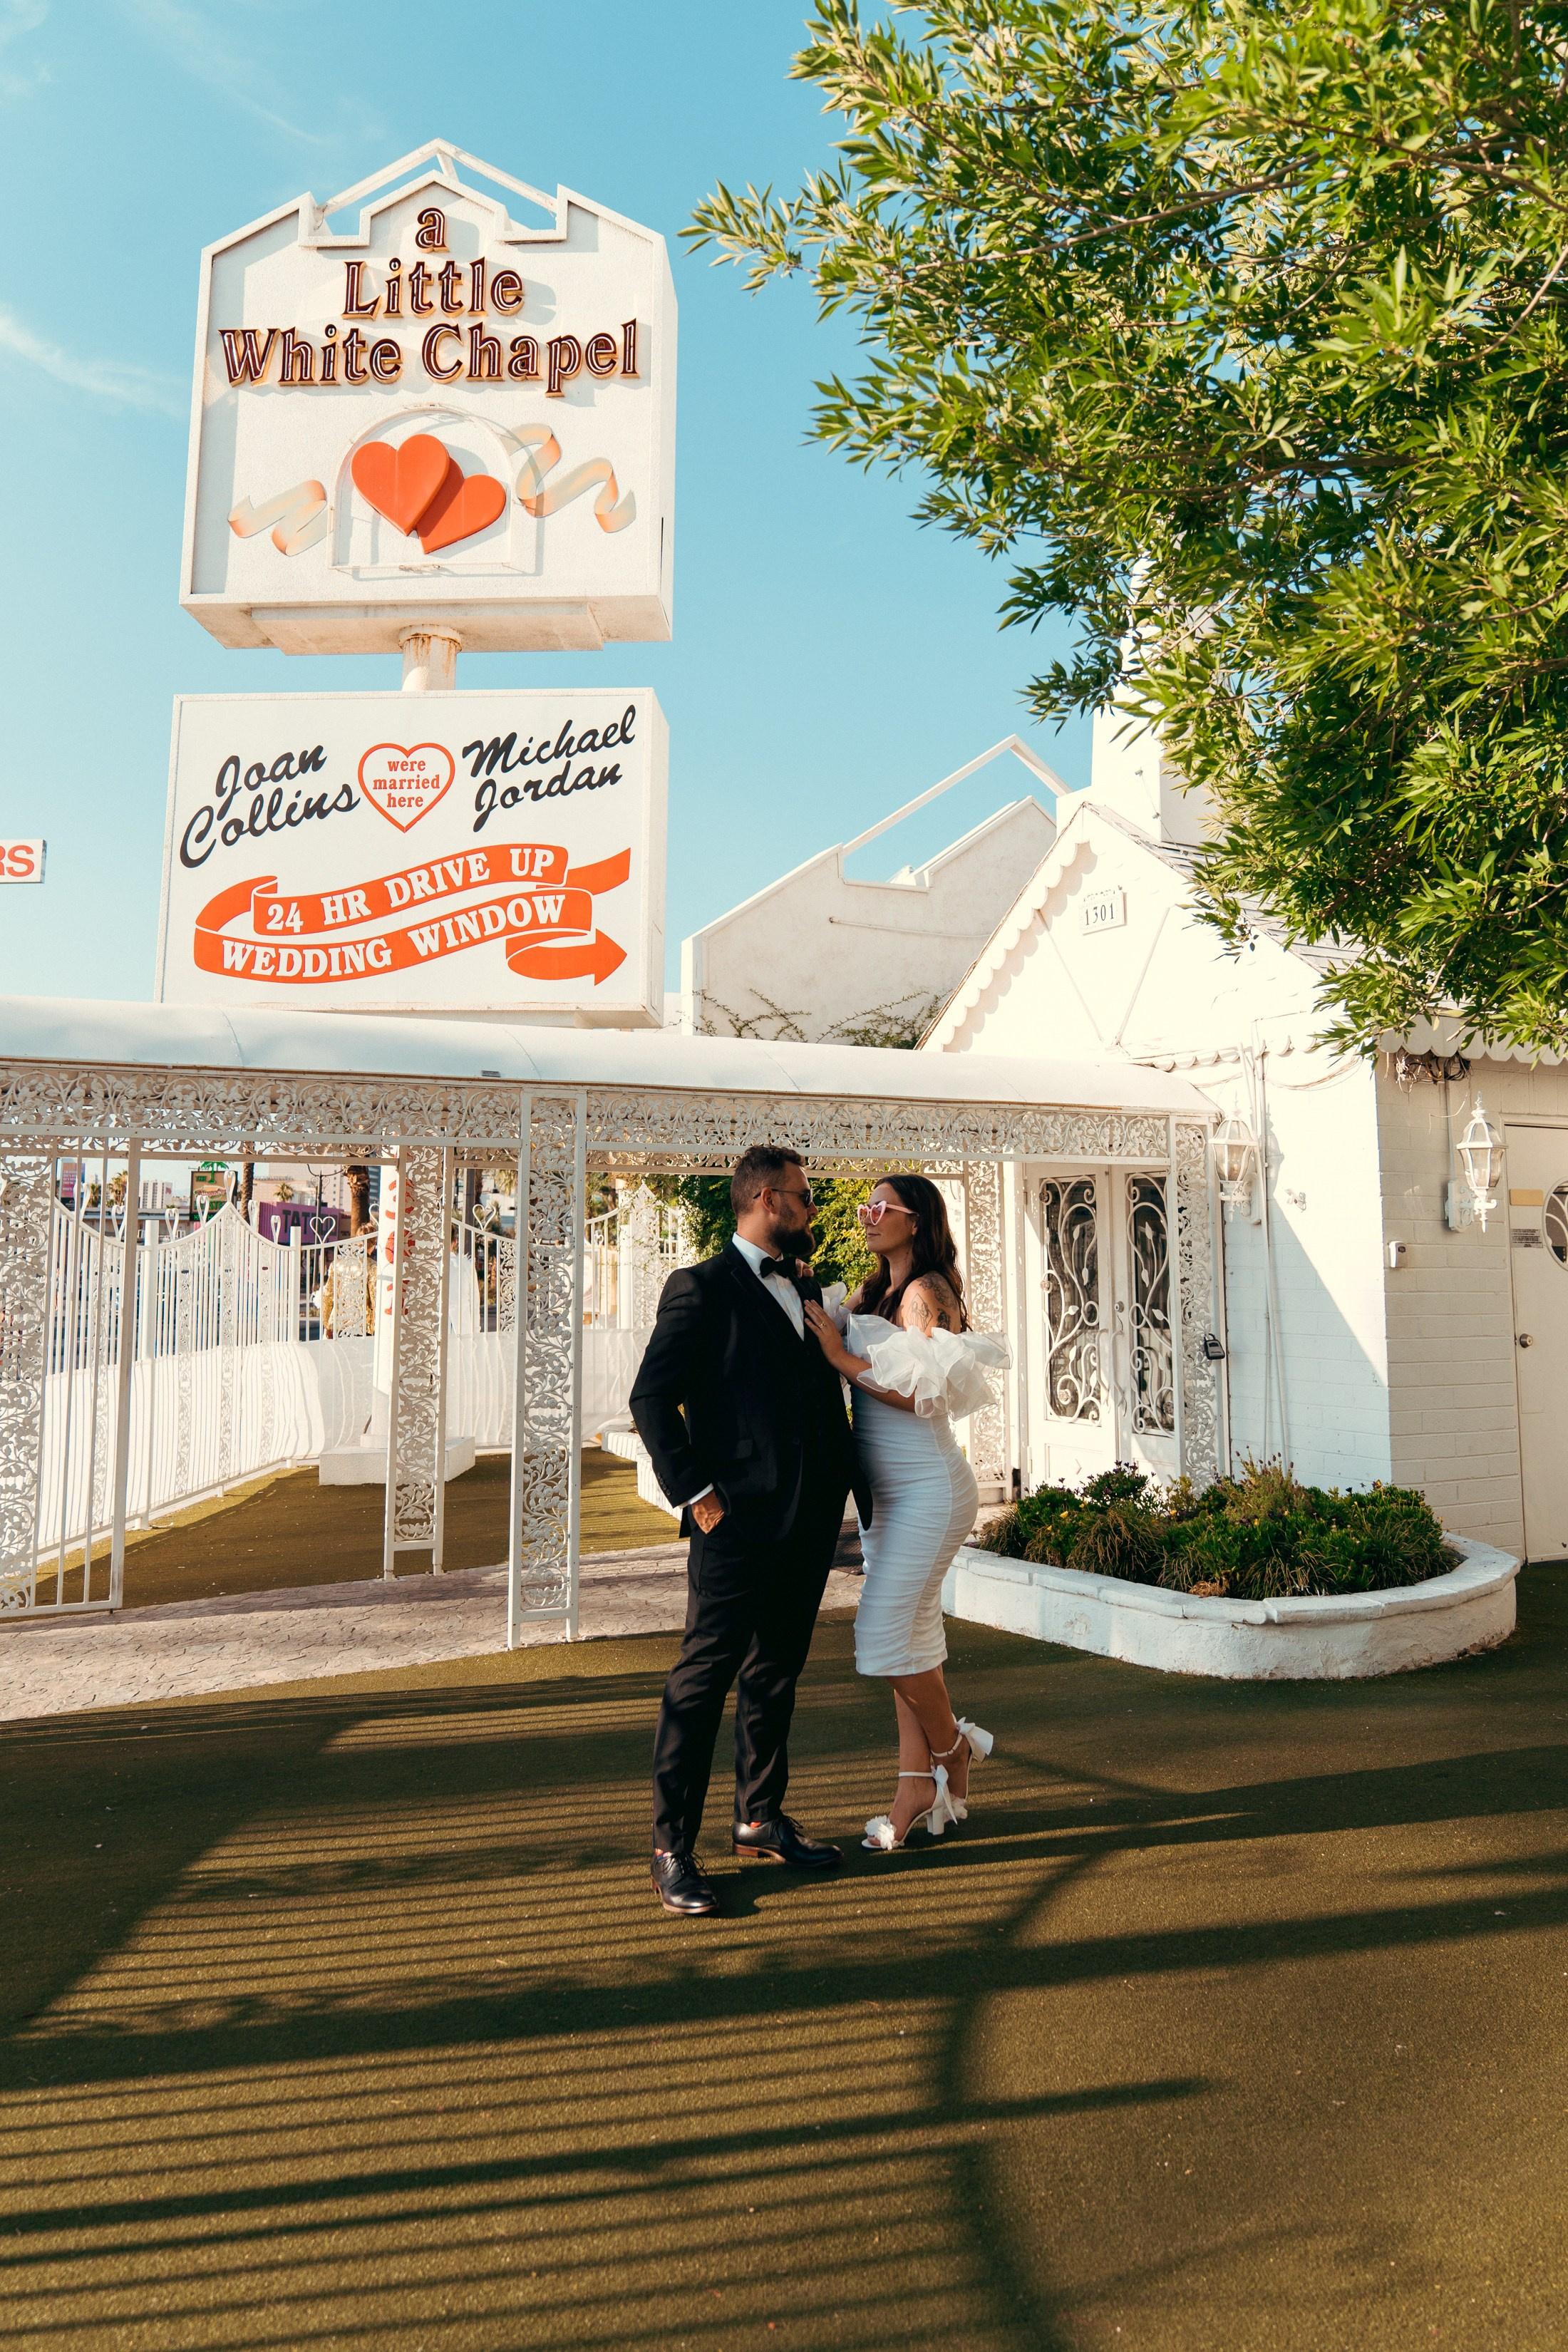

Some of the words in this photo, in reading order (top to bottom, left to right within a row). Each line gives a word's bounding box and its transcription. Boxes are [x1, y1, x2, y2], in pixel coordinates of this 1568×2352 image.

[415, 207, 448, 252] a
[342, 257, 525, 320] Little
[218, 324, 404, 387] White
[422, 319, 640, 398] Chapel
[387, 760, 425, 772] were
[463, 705, 636, 777] Michael
[216, 746, 327, 820] Joan
[373, 775, 440, 789] married
[387, 793, 423, 808] here
[473, 760, 623, 832] Jordan
[180, 784, 360, 868] Collins
[0, 845, 34, 877] S
[267, 902, 304, 932] 24
[321, 889, 371, 925] HR
[384, 852, 490, 907] DRIVE
[510, 849, 555, 877] UP
[222, 938, 392, 977] WEDDING
[408, 894, 566, 956] WINDOW
[1085, 903, 1114, 926] 1301
